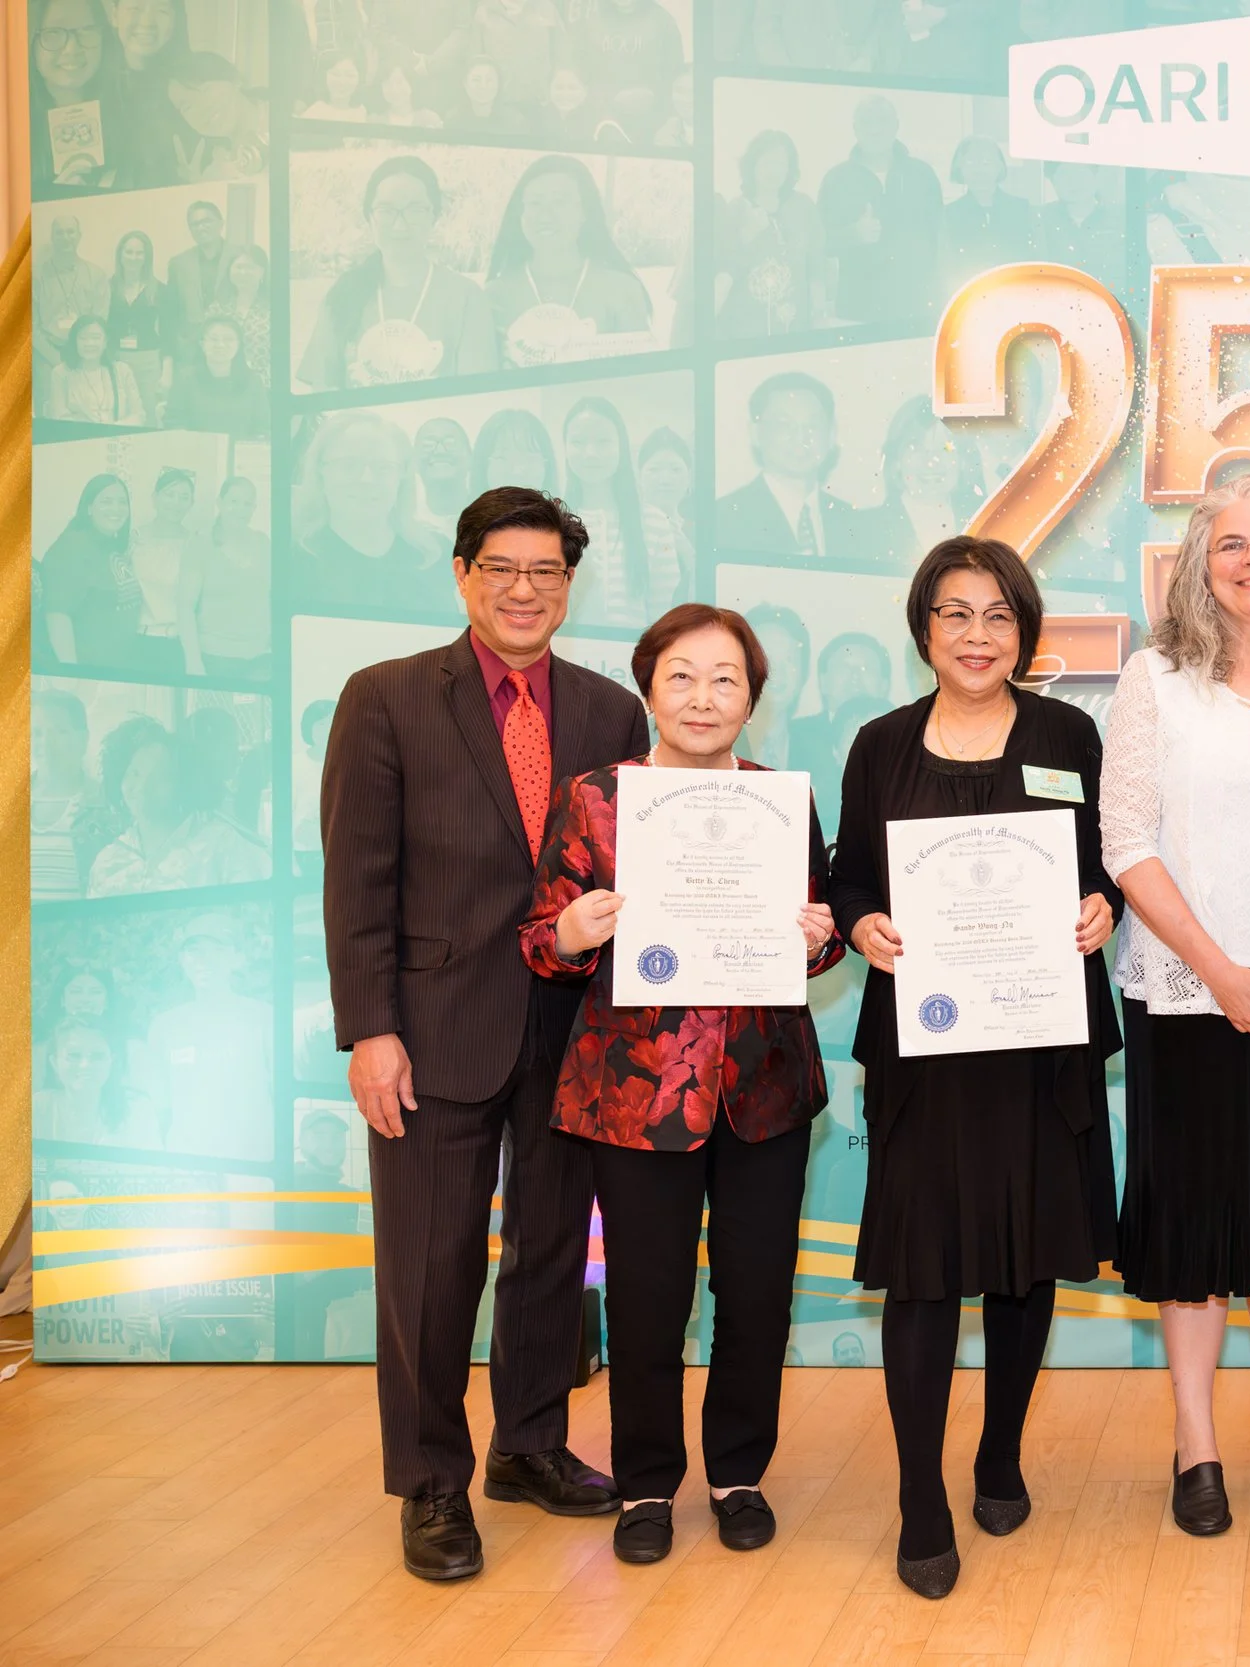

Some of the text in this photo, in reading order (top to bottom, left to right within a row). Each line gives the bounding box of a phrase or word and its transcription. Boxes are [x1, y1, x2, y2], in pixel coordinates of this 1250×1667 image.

[1033, 61, 1230, 146] QARI
[634, 780, 793, 828] The Commonwealth of Massachusetts
[904, 826, 1057, 876] The Commonwealth of Massachusetts
[42, 1317, 125, 1345] POWER
